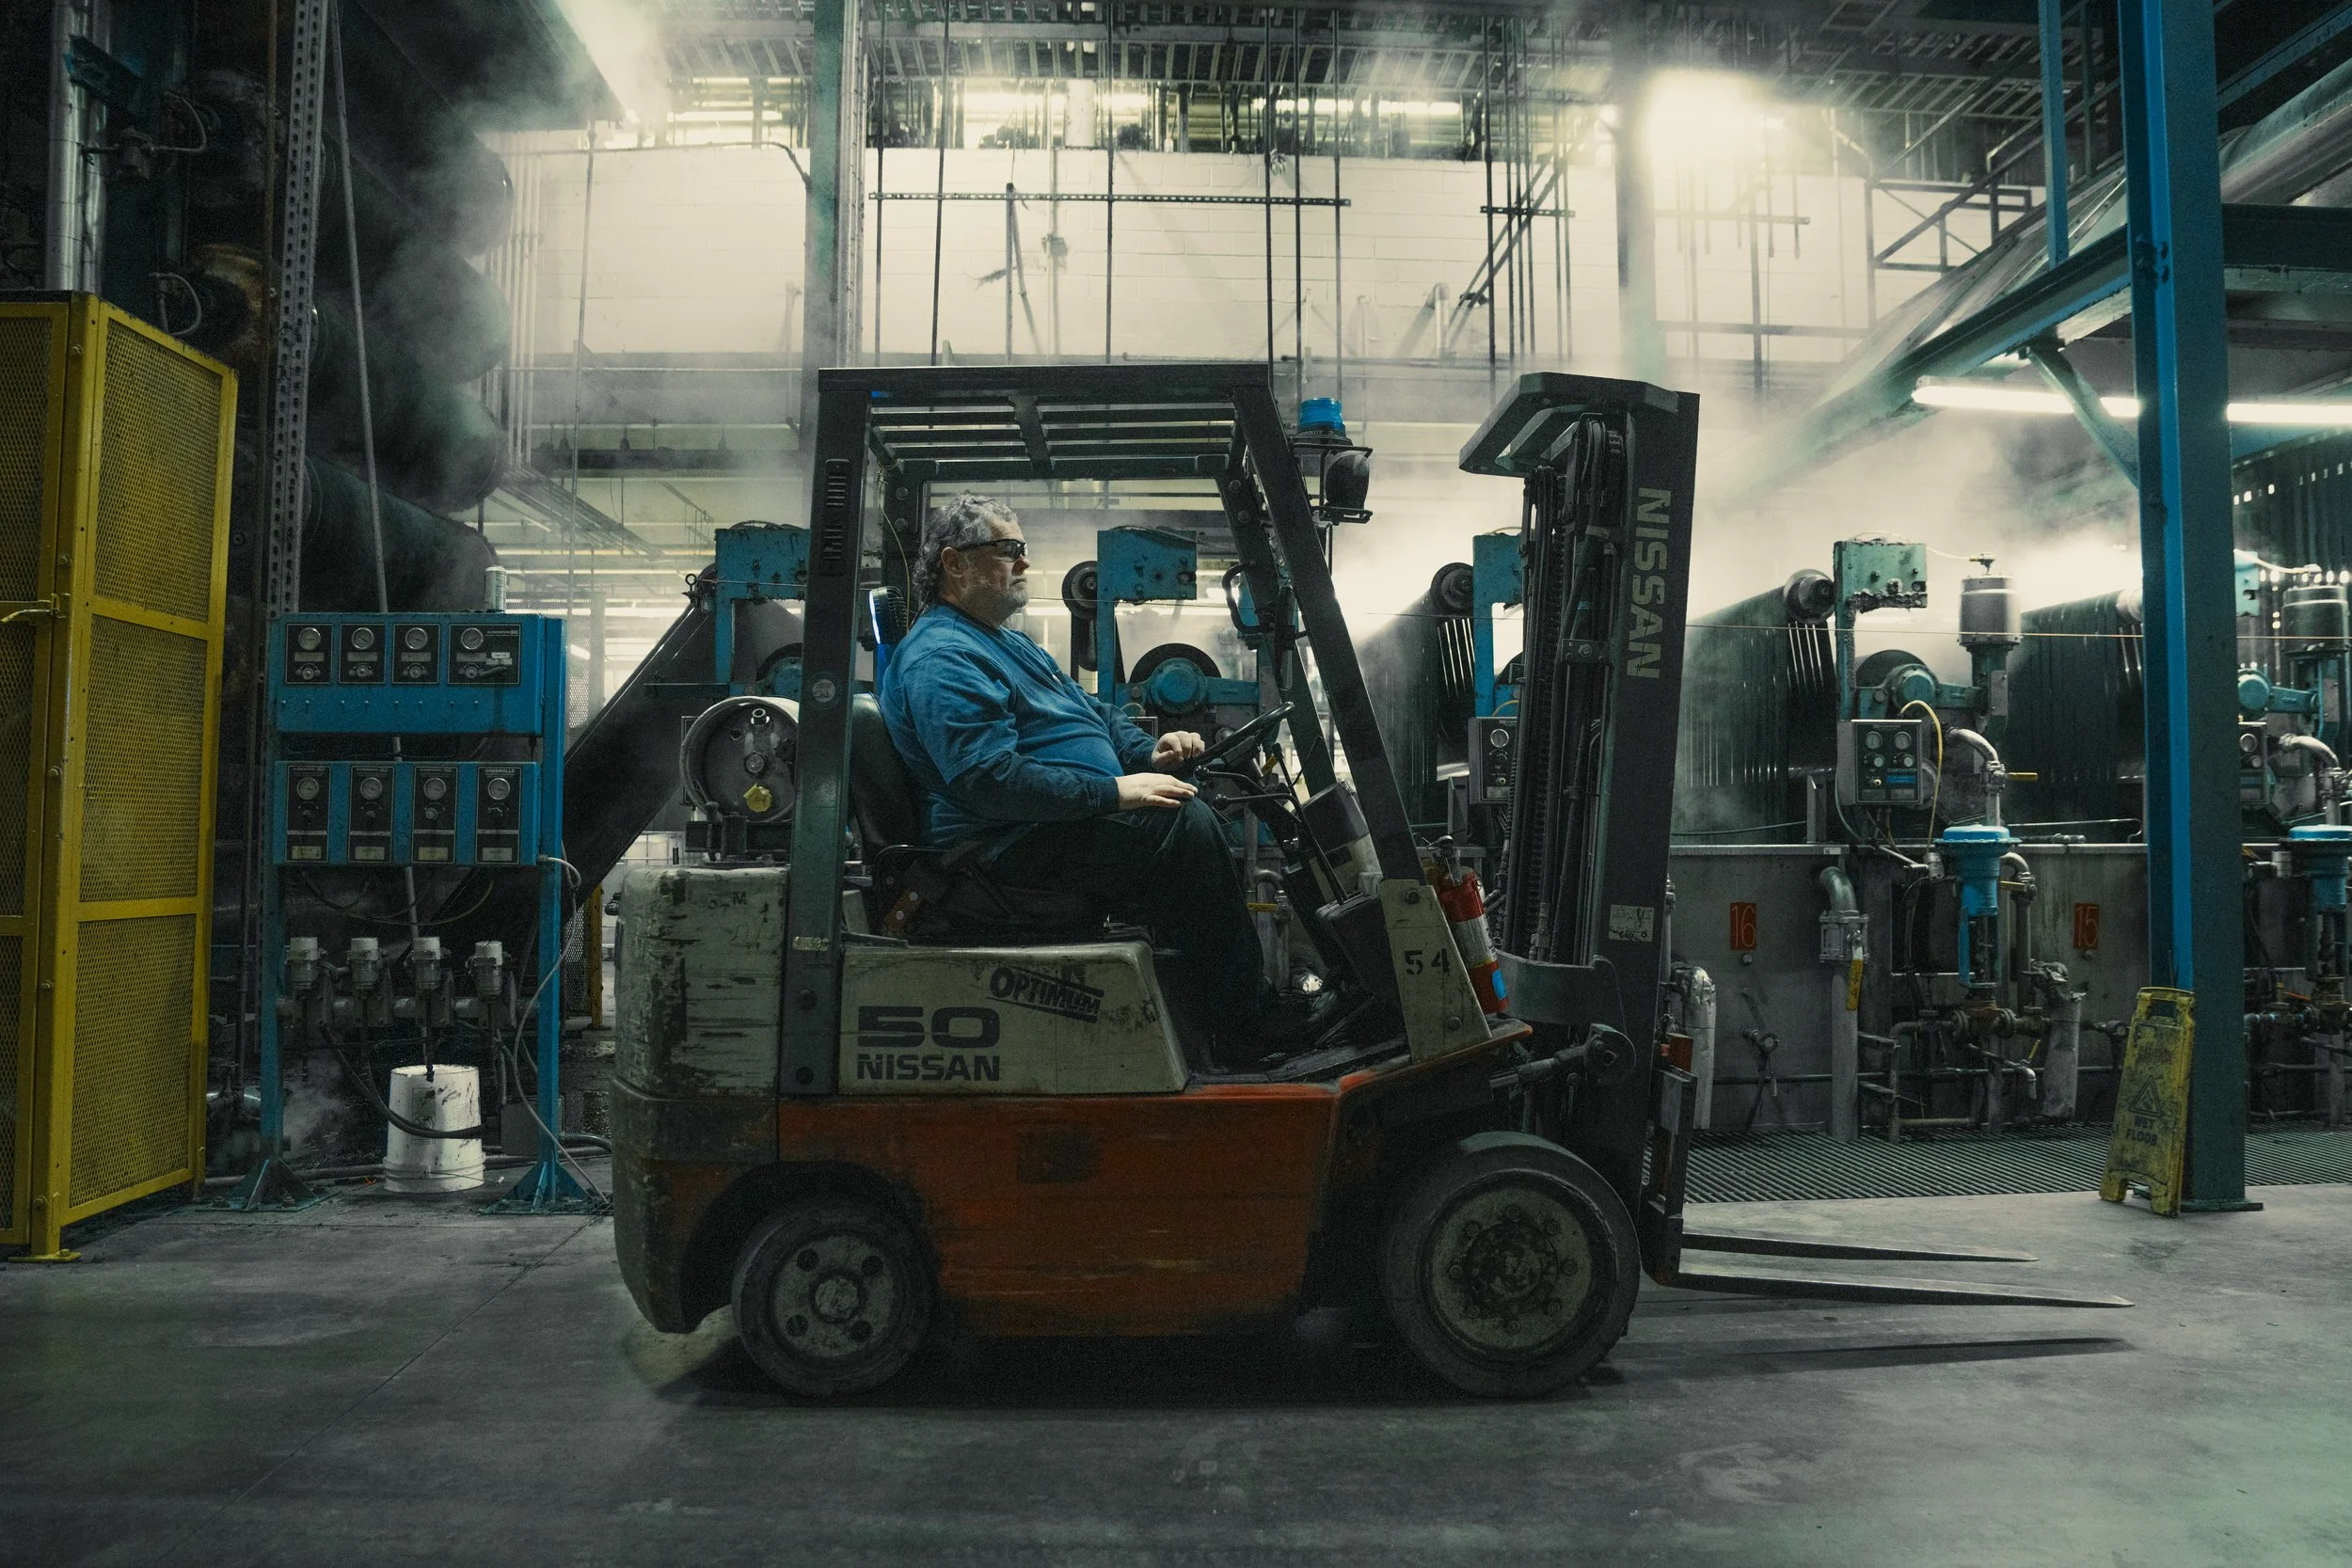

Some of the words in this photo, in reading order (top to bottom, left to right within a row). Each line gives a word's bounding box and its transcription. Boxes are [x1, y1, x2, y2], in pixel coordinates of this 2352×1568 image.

[1628, 487, 1672, 679] NISSAN
[1731, 906, 1756, 947] 16
[2076, 906, 2099, 947] 15
[1405, 948, 1449, 975] 54
[990, 966, 1101, 1015] OPTIMUM
[857, 1006, 1000, 1049] 50
[857, 1053, 1000, 1081] NISSAN
[2125, 1127, 2158, 1146] FLOOR
[2134, 1116, 2154, 1130] WET
